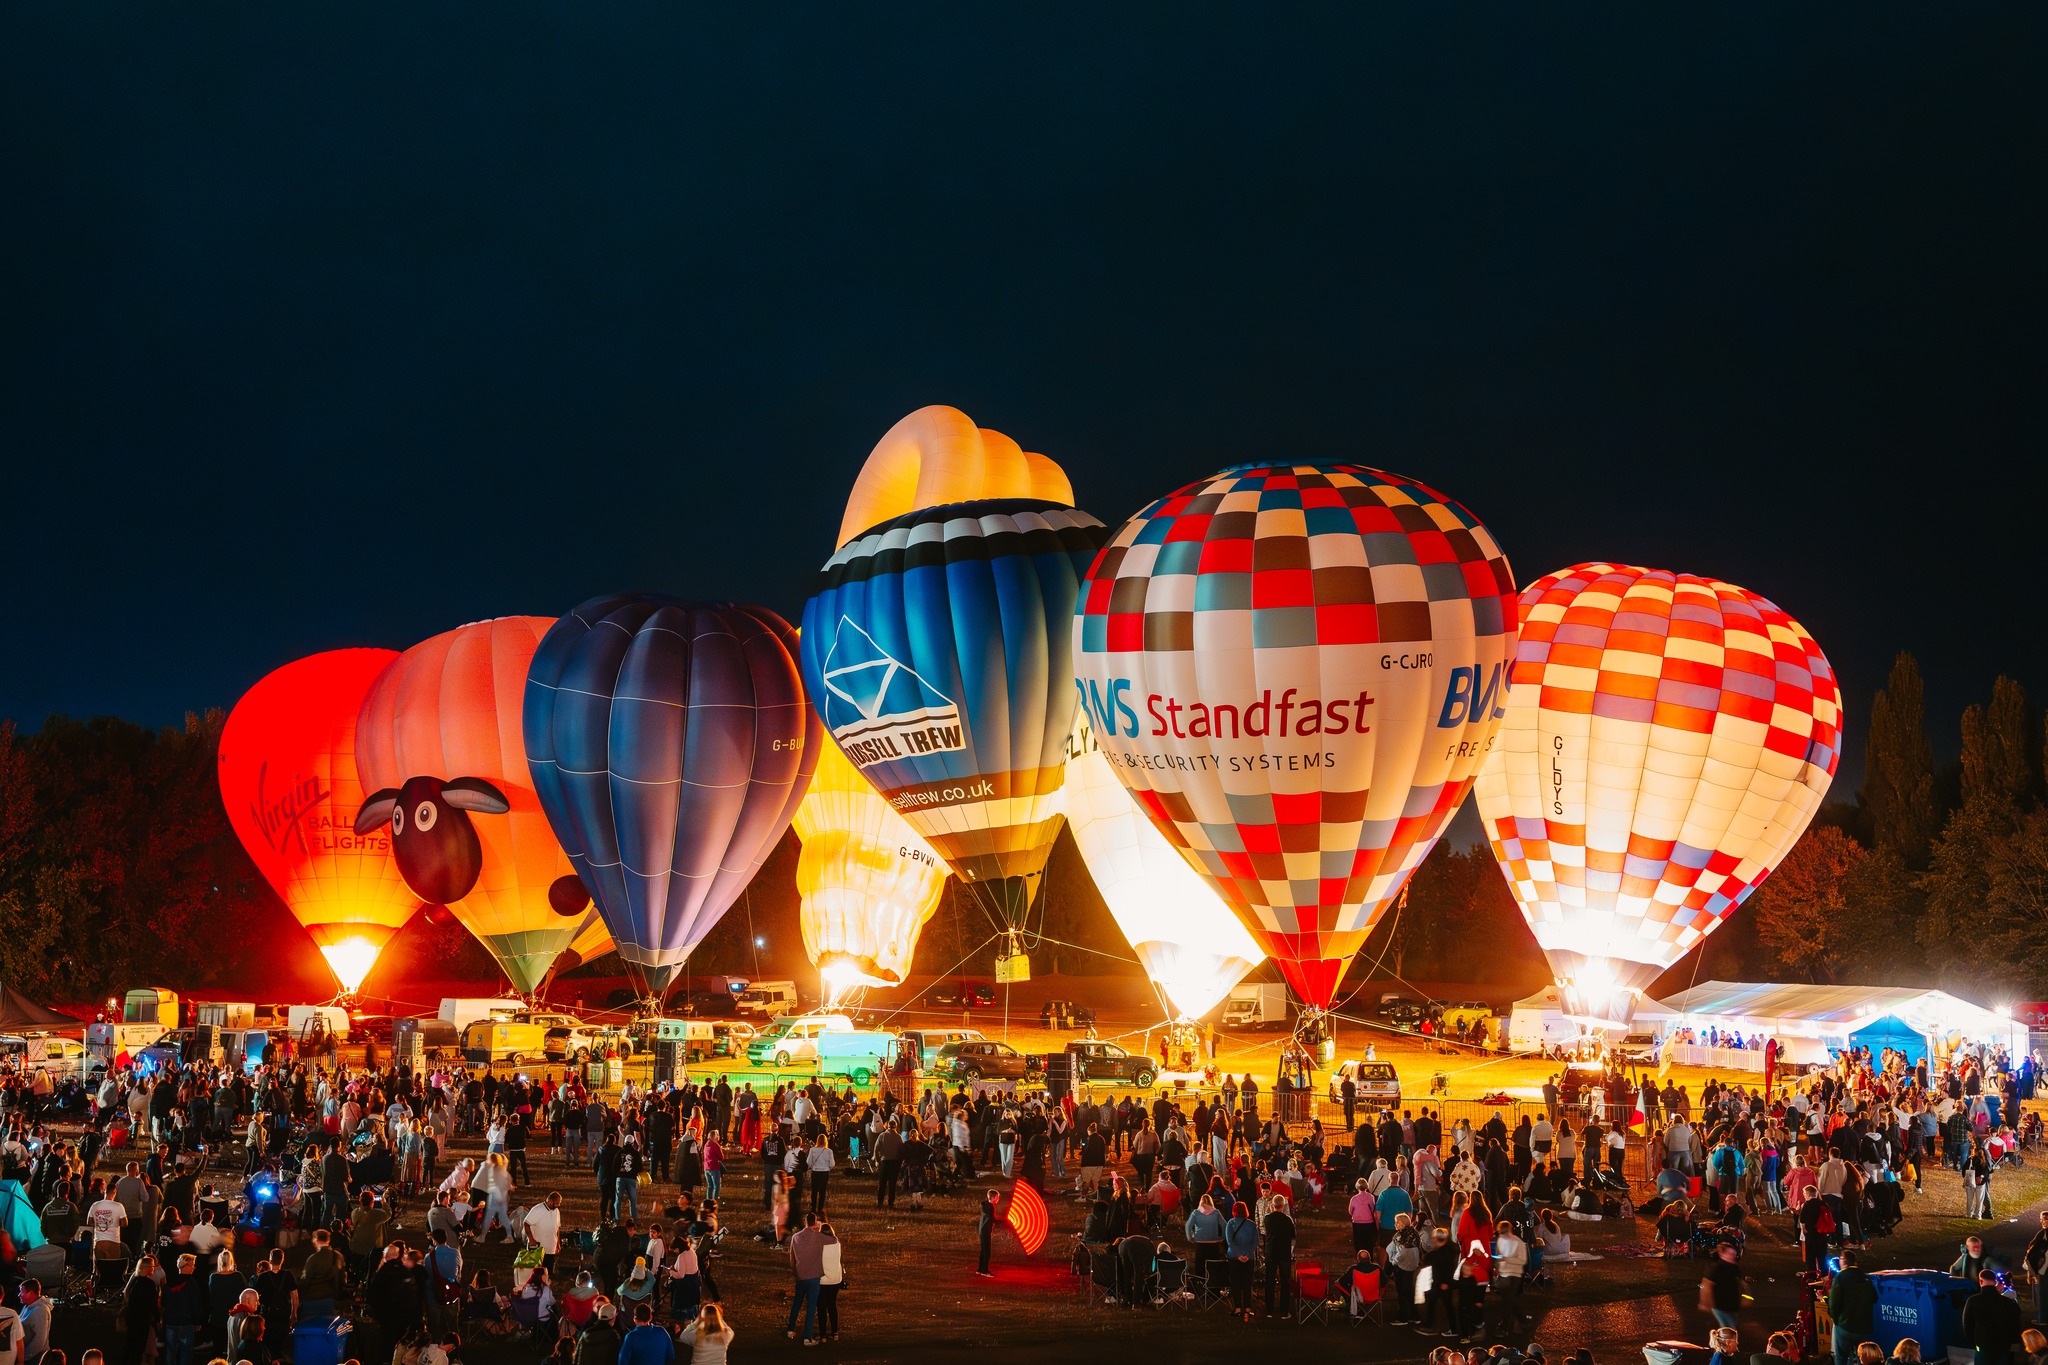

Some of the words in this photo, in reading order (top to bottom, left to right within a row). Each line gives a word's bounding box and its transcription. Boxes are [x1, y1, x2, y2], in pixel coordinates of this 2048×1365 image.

[1147, 688, 1375, 739] Standfast
[899, 724, 962, 754] TREW
[1136, 753, 1220, 772] SECURITY
[1229, 752, 1336, 772] SYSTEMS
[250, 760, 330, 856] Virgin
[307, 816, 355, 829] BALL
[311, 836, 389, 850] FLIGHTS
[1881, 1304, 1893, 1315] PG
[1894, 1306, 1917, 1318] SKIPS
